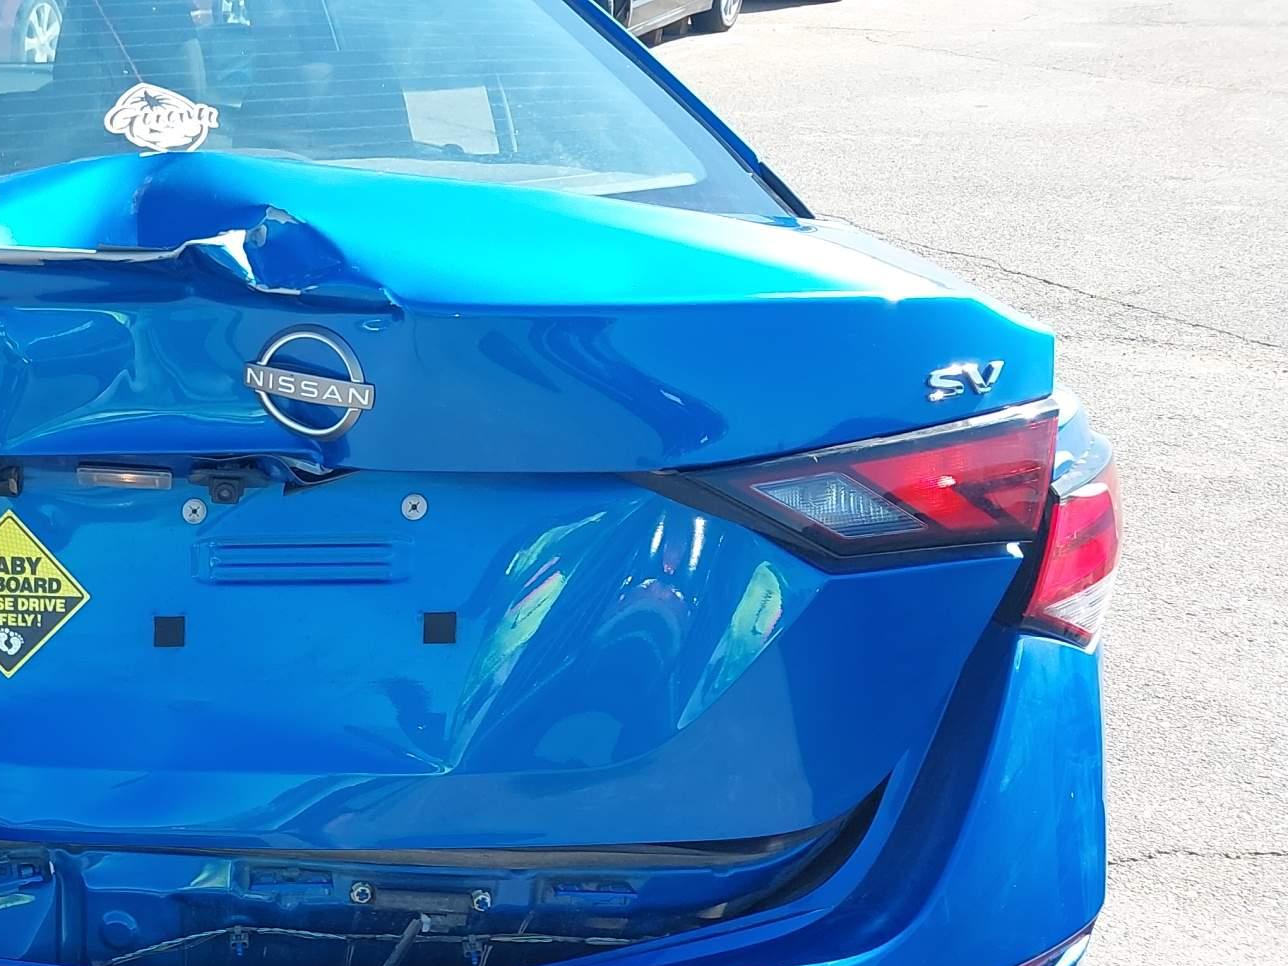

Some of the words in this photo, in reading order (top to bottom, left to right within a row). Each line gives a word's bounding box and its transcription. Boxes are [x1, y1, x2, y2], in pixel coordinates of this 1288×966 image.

[246, 367, 370, 406] NISSAN
[928, 360, 1005, 402] SV
[17, 599, 66, 612] DRIVE
